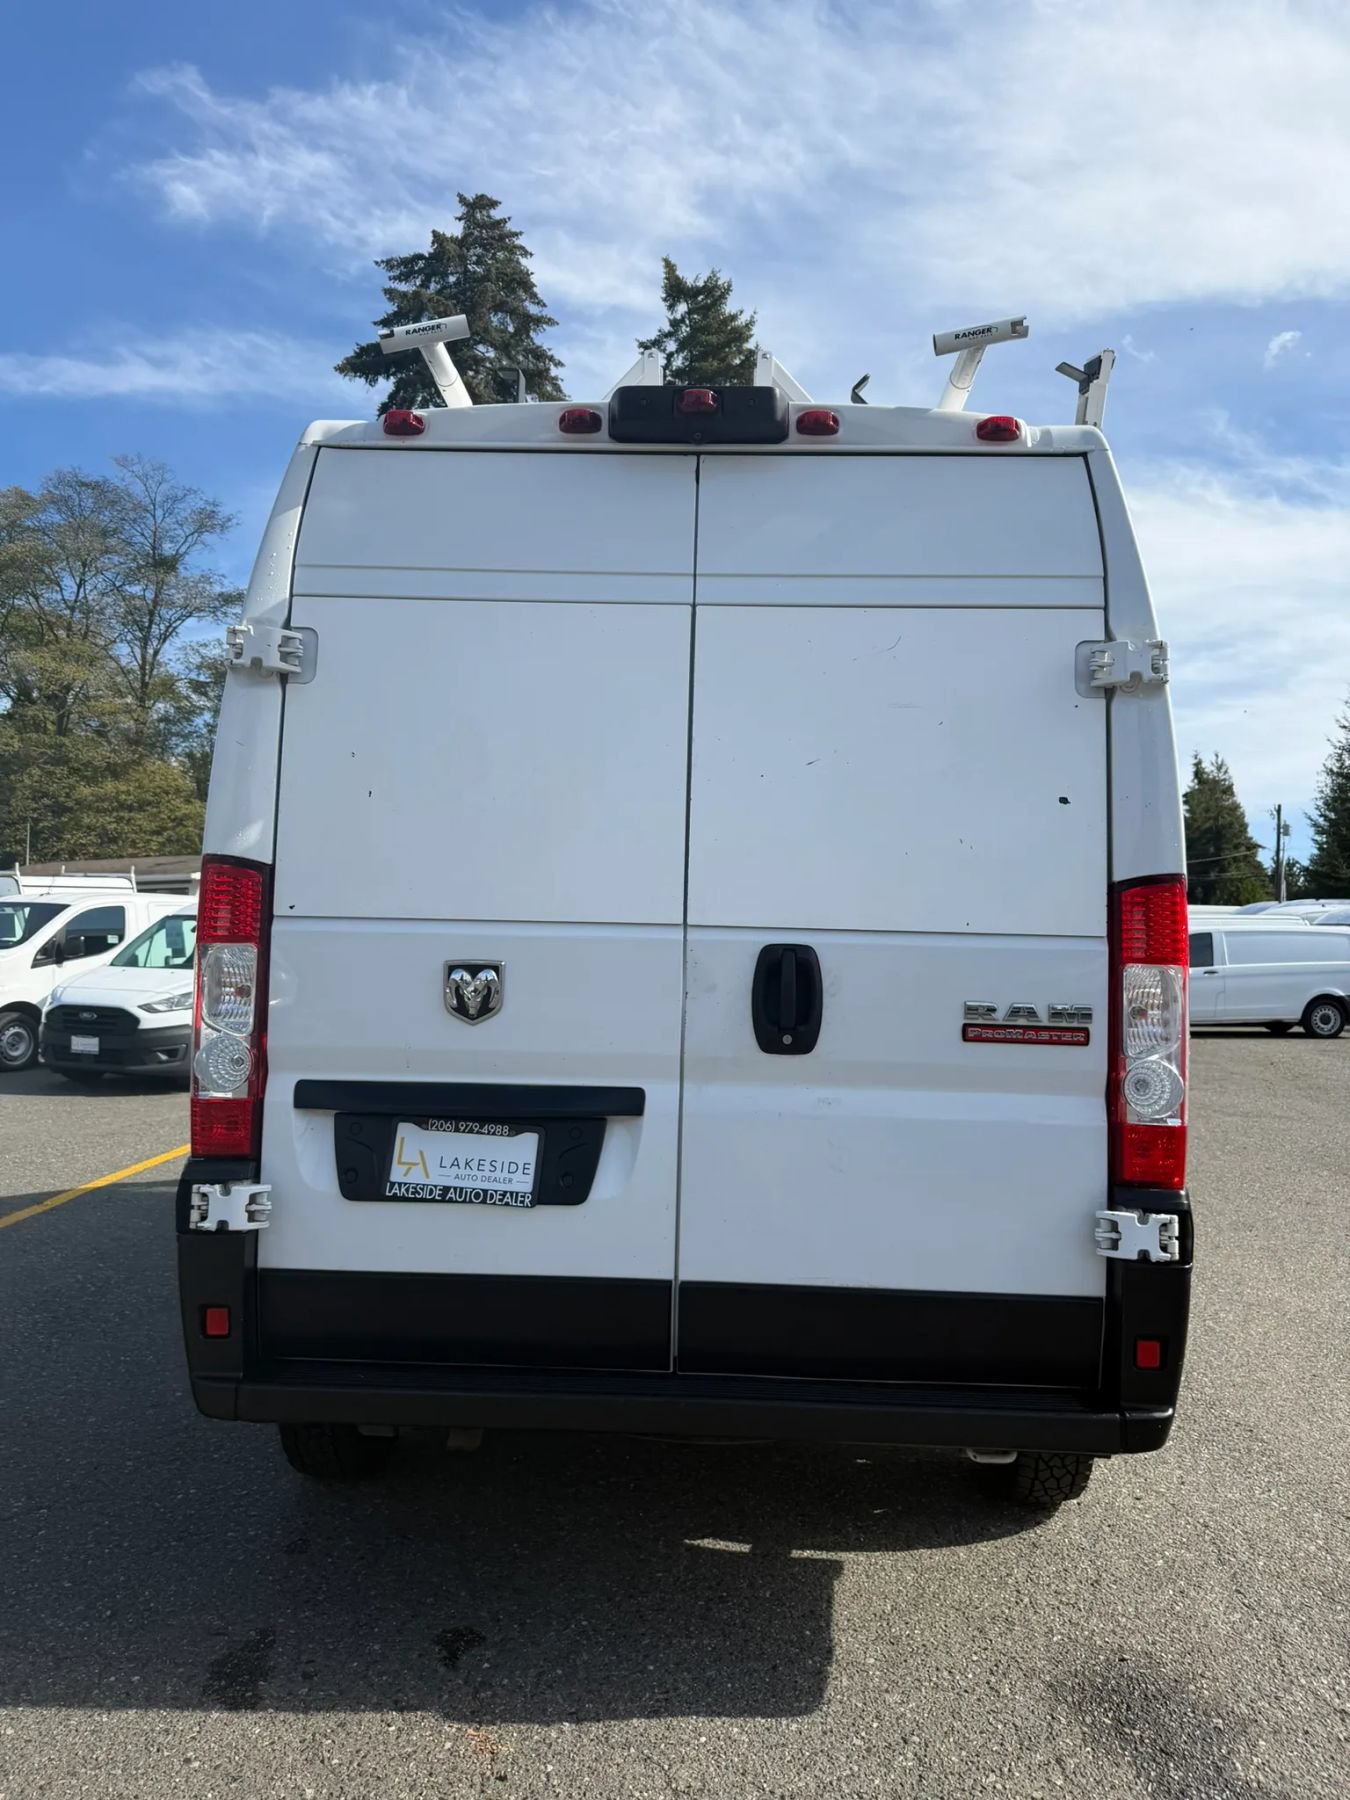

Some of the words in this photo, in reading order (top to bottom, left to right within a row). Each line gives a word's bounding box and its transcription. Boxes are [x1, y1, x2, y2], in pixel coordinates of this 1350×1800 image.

[405, 324, 441, 336] RANGER
[954, 327, 992, 340] RANGER
[964, 1000, 1093, 1024] RAM
[428, 1118, 456, 1132] (206)
[458, 1121, 509, 1136] 979-4988
[439, 1155, 532, 1176] LAKESIDE
[453, 1173, 478, 1183] AUTO
[481, 1175, 513, 1185] DEALER
[385, 1182, 443, 1200] LAKESIDE
[446, 1187, 483, 1203] AUTO
[486, 1191, 532, 1207] DEALER
